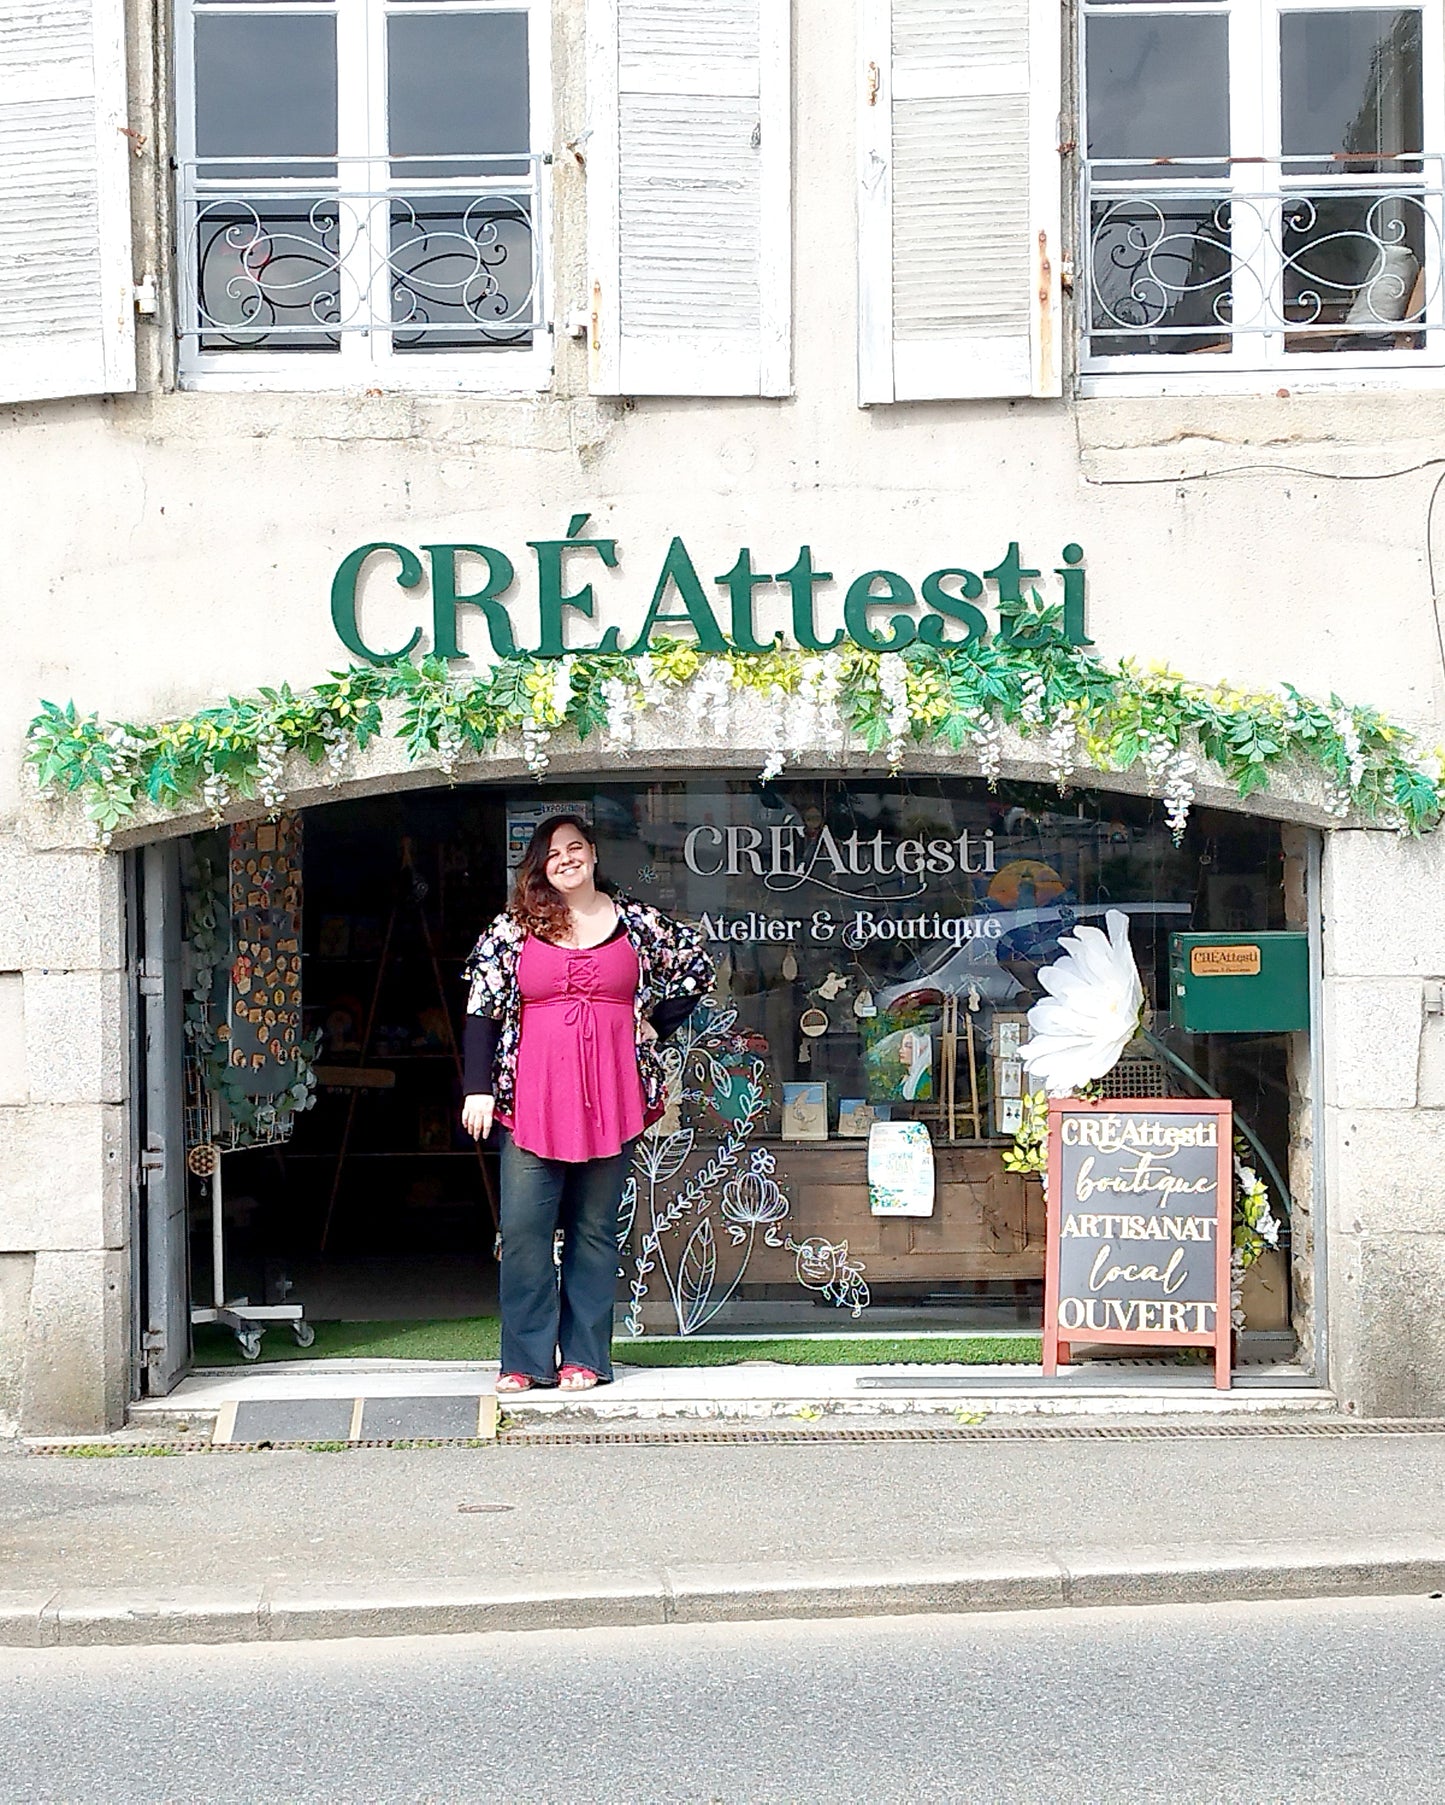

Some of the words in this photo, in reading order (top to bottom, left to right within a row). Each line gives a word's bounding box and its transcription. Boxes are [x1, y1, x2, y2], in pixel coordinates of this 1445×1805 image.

[331, 513, 1096, 661] CRÉAttesti
[685, 816, 998, 900] CRÉAttesti
[701, 912, 801, 942] Atelier
[812, 911, 835, 941] &
[843, 912, 1001, 949] Boutique
[1062, 1115, 1218, 1159] CRÉAttesti
[1077, 1155, 1217, 1208] boutique
[1061, 1215, 1218, 1241] ARTISANAT
[1089, 1245, 1188, 1295] local
[1058, 1298, 1217, 1334] OUVERT
